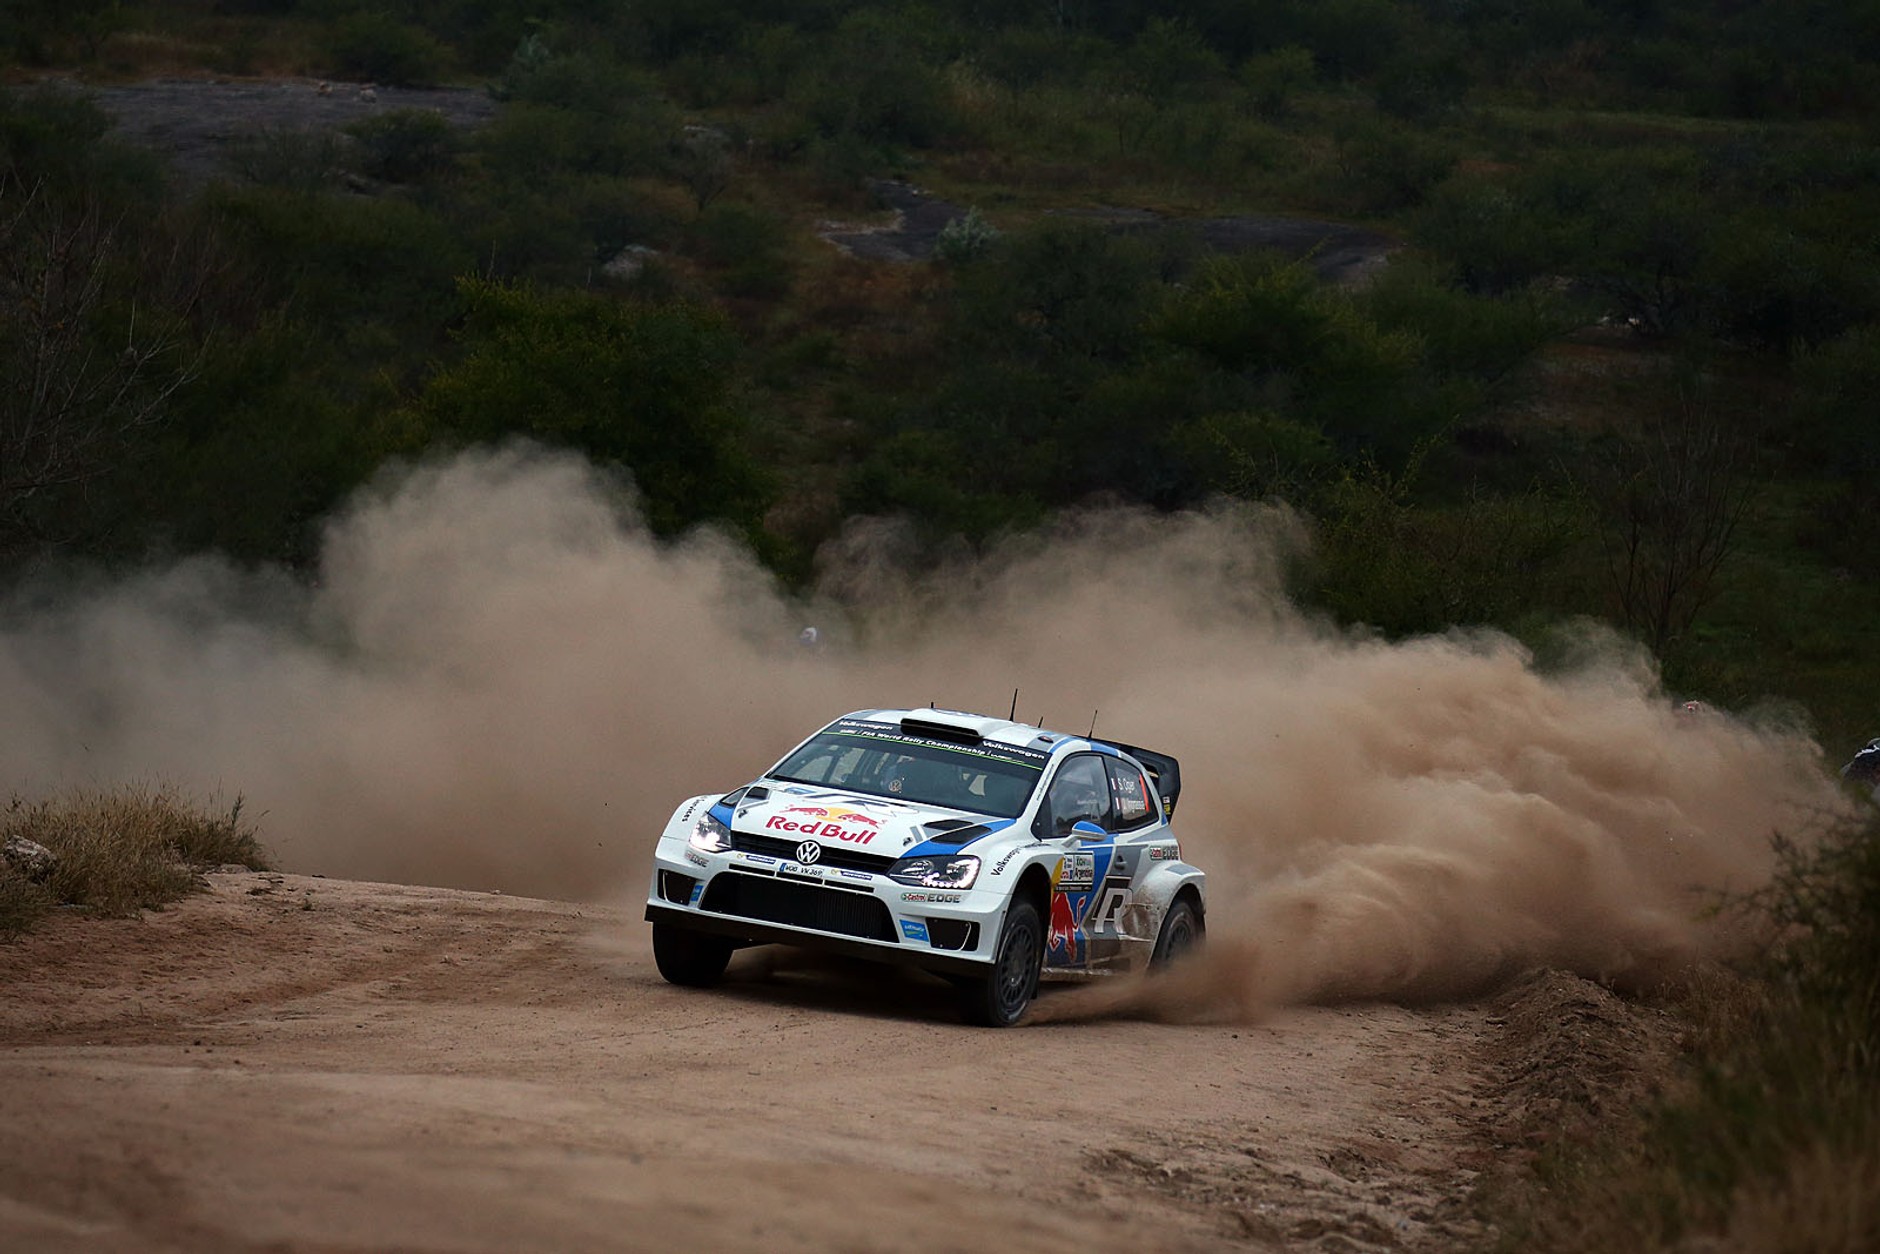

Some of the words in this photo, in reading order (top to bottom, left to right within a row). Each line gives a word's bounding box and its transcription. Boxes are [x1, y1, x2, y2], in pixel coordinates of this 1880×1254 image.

[839, 720, 893, 731] Volkswagen
[903, 736, 925, 744] Rally
[926, 740, 986, 756] Championship
[982, 740, 1045, 760] Volkswagen
[765, 815, 822, 835] Red
[819, 823, 878, 845] Bull
[927, 893, 962, 904] EDGE
[1094, 887, 1134, 933] R
